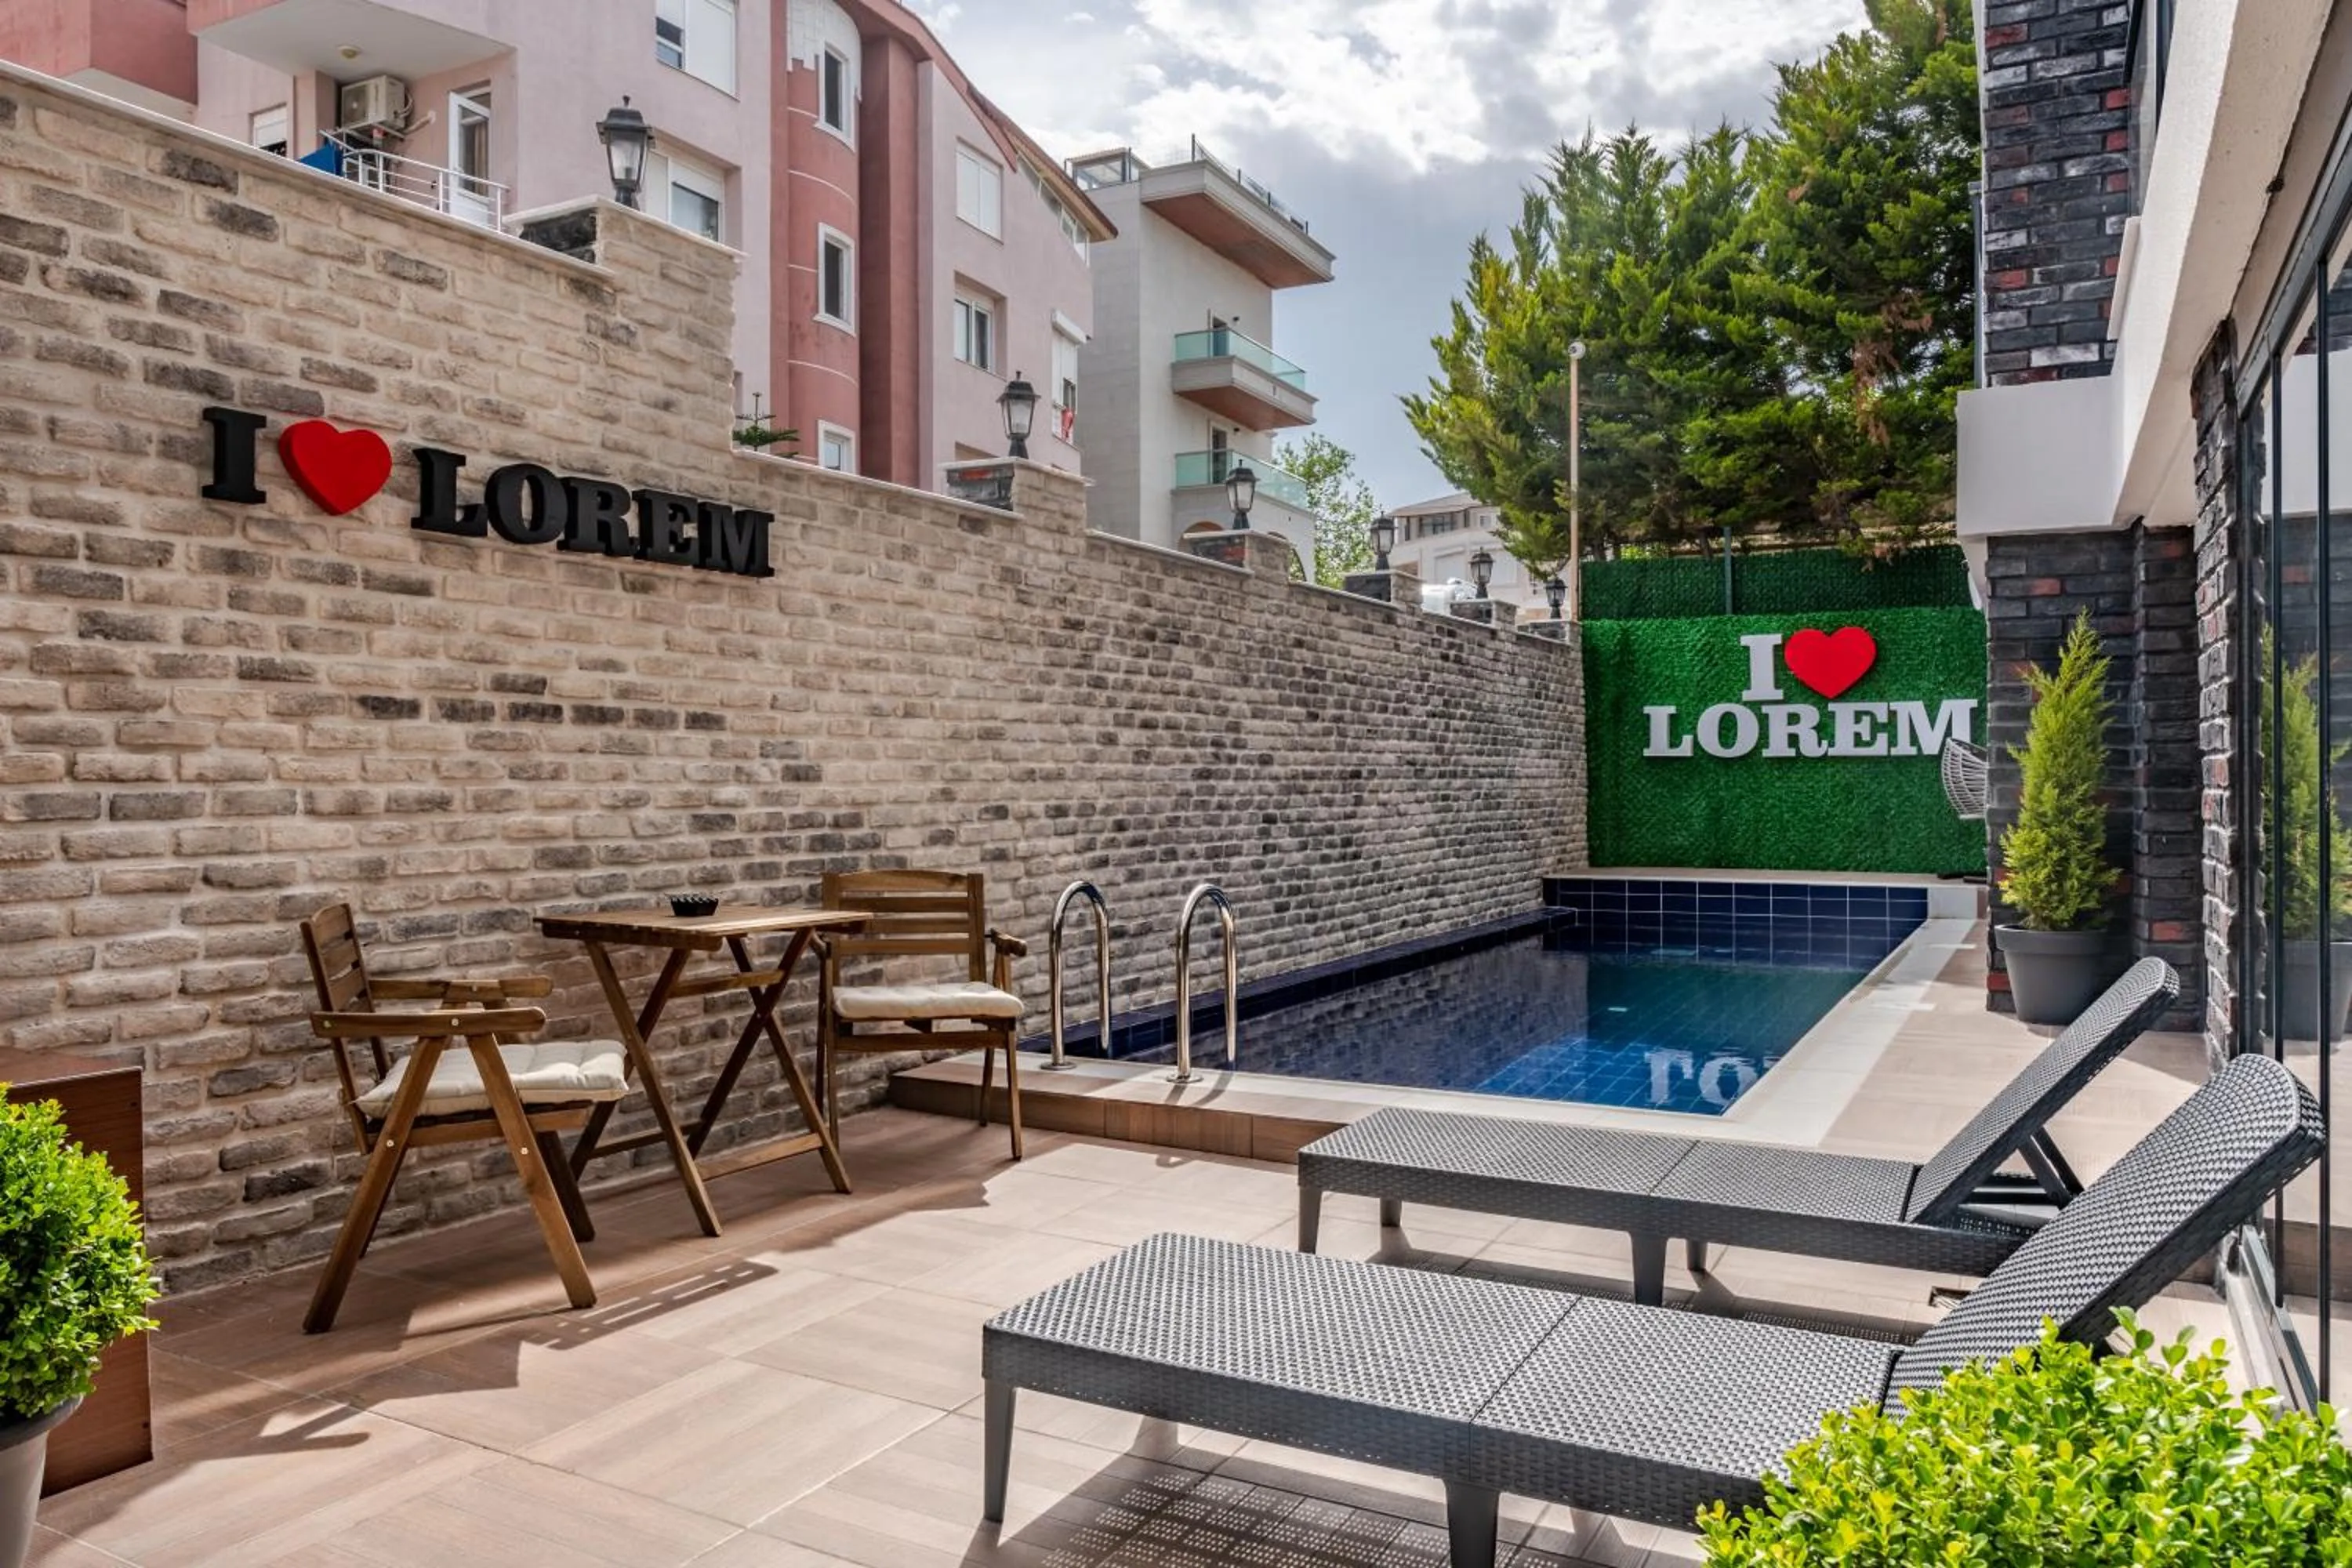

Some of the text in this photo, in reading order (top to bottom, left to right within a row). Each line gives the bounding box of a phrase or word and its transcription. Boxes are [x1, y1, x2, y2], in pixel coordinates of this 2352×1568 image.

[201, 406, 775, 577] I LOREM
[1740, 633, 1784, 701] I
[1643, 699, 1978, 757] LOREM
